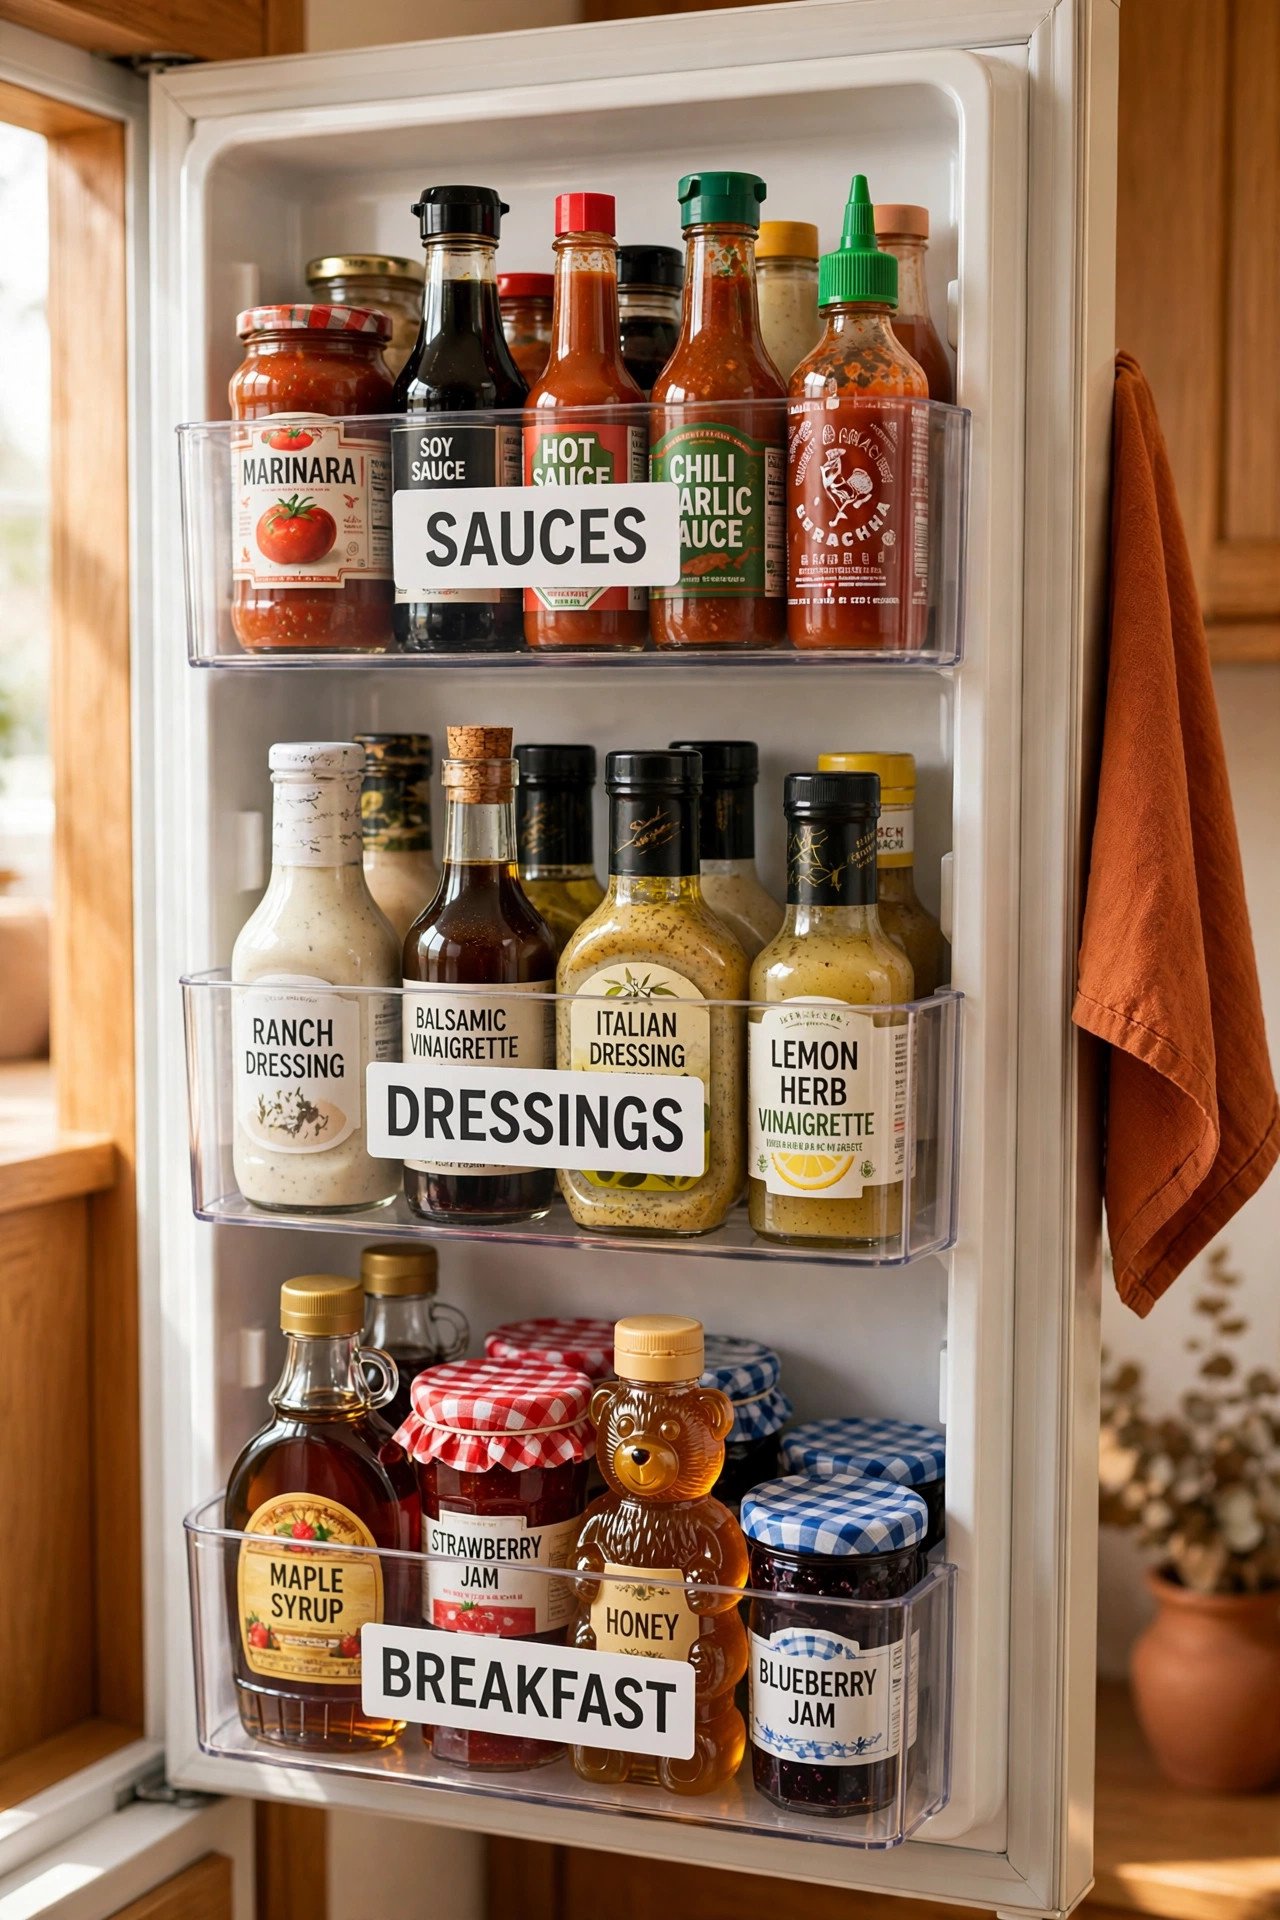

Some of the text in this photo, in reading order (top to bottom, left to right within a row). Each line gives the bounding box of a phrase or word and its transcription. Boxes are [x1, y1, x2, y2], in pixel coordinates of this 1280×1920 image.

[419, 436, 454, 458] SOY
[542, 437, 595, 464] HOT
[243, 456, 356, 486] MARINARA
[411, 460, 466, 481] SAUCE
[533, 466, 610, 486] SAUCE
[669, 453, 735, 484] CHILI
[679, 486, 752, 515] ARLIC
[426, 506, 647, 567] SAUCES
[679, 519, 743, 548] AUCE
[252, 1017, 333, 1046] RANCH
[416, 1006, 507, 1031] BALSAMIC
[597, 1010, 677, 1037] ITALIAN
[410, 1033, 519, 1060] VINAIGRETTE
[590, 1042, 685, 1068] DRESSING
[771, 1039, 858, 1070] LEMON
[245, 1051, 345, 1078] DRESSING
[781, 1075, 847, 1106] HERB
[387, 1084, 684, 1153] DRESSINGS
[758, 1107, 875, 1137] VINAIGRETTE
[431, 1528, 542, 1560] STRAWBERRY
[270, 1562, 344, 1594] MAPLE
[460, 1565, 499, 1590] JAM
[271, 1592, 344, 1624] SYRUP
[606, 1606, 680, 1641] HONEY
[382, 1646, 677, 1734] BREAKFAST
[759, 1657, 877, 1698] BLUEBERRY
[788, 1699, 836, 1729] JAM
